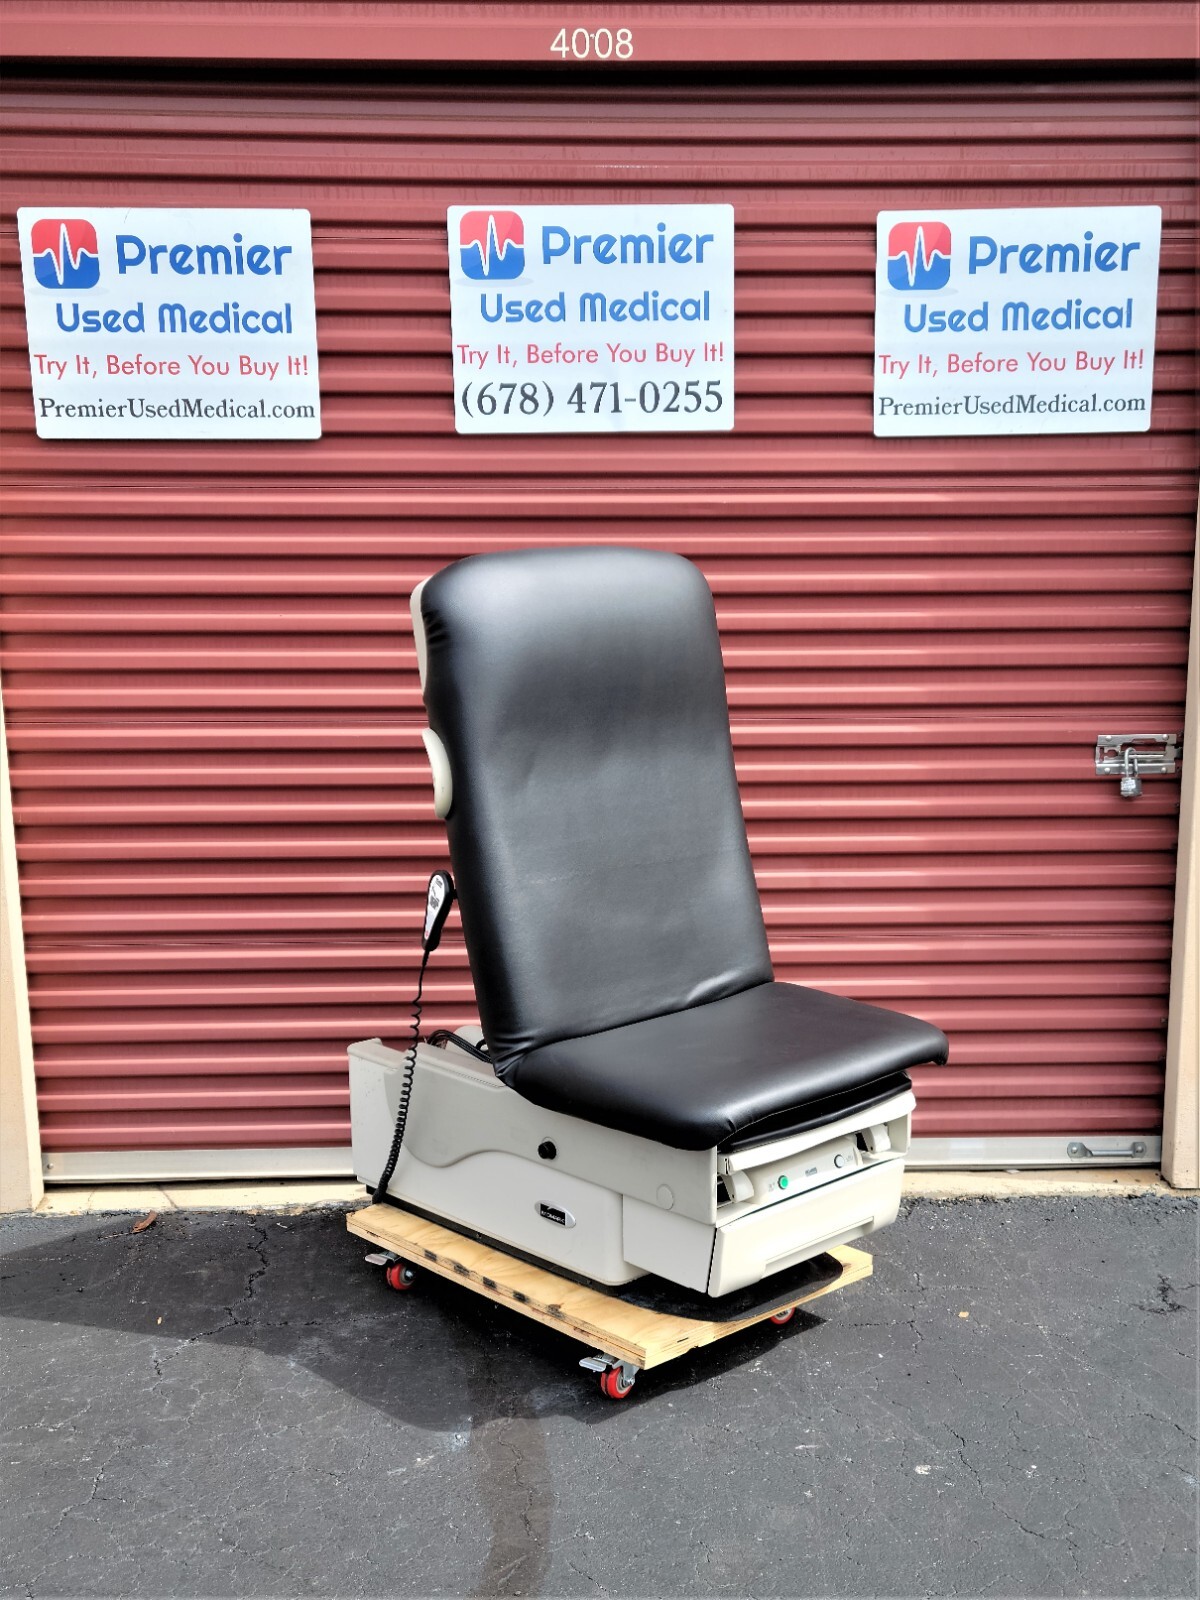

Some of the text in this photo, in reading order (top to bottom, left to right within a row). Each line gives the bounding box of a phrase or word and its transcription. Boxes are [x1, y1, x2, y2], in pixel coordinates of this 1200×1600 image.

[550, 27, 634, 59] 4008
[115, 233, 292, 275] Premier
[542, 222, 714, 264] Premier
[969, 231, 1140, 274] Premier
[56, 302, 292, 334] Used Medical
[480, 290, 710, 323] Used Medical
[904, 298, 1133, 332] Used Medical
[34, 354, 308, 380] Try It, Before You Buy It!
[457, 342, 724, 369] Try It, Before You Buy It!
[879, 349, 1144, 379] Try It, Before You Buy It!
[39, 398, 315, 419] PremierUsedMedical.com
[461, 380, 723, 418] (678) 471-0255
[879, 394, 1146, 416] PremierUsedMedical.com
